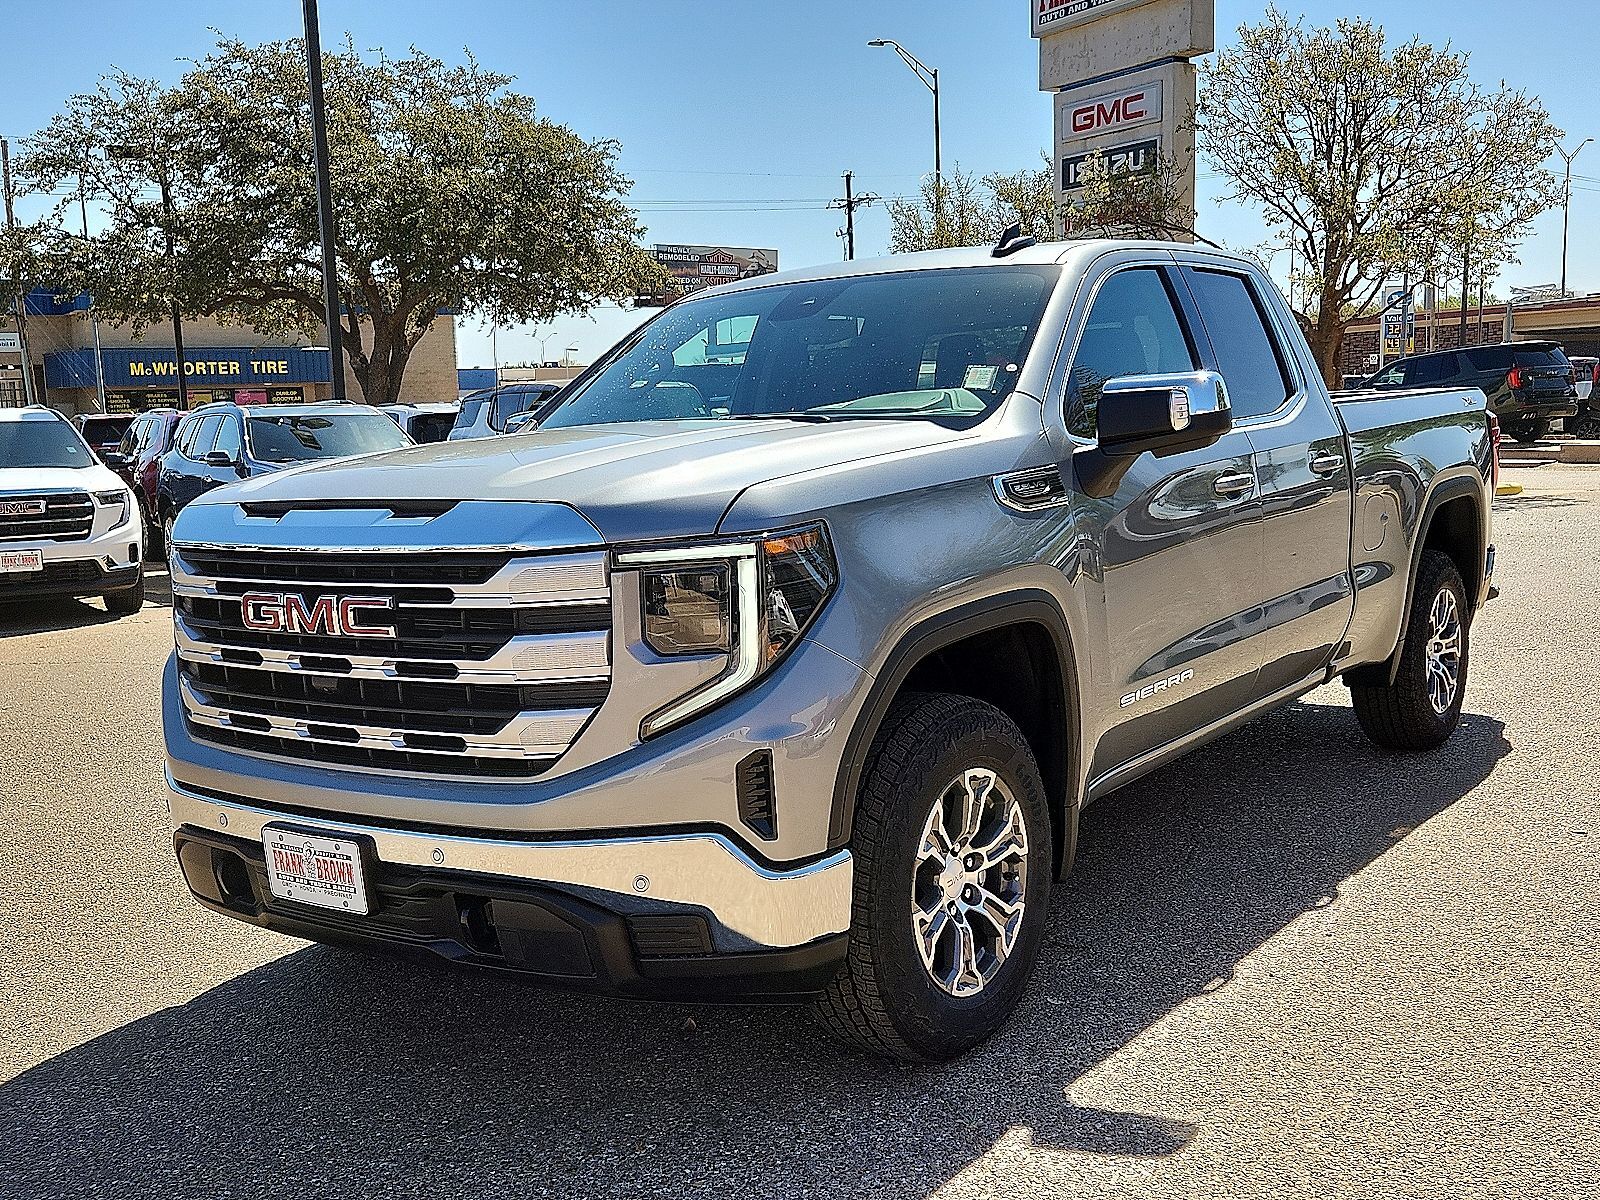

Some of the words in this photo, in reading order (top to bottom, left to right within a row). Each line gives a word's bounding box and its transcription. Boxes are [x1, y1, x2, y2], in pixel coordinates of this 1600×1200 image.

[1041, 9, 1065, 24] AUTO
[1068, 1, 1088, 15] AND
[1072, 93, 1145, 132] GMC
[658, 253, 700, 262] REMODELED
[129, 361, 240, 376] McWHORTER
[250, 360, 289, 374] TIRE
[241, 591, 396, 638] GMC
[1119, 668, 1194, 708] SIERRA
[272, 849, 305, 877] FRANK
[314, 857, 355, 886] BROWN
